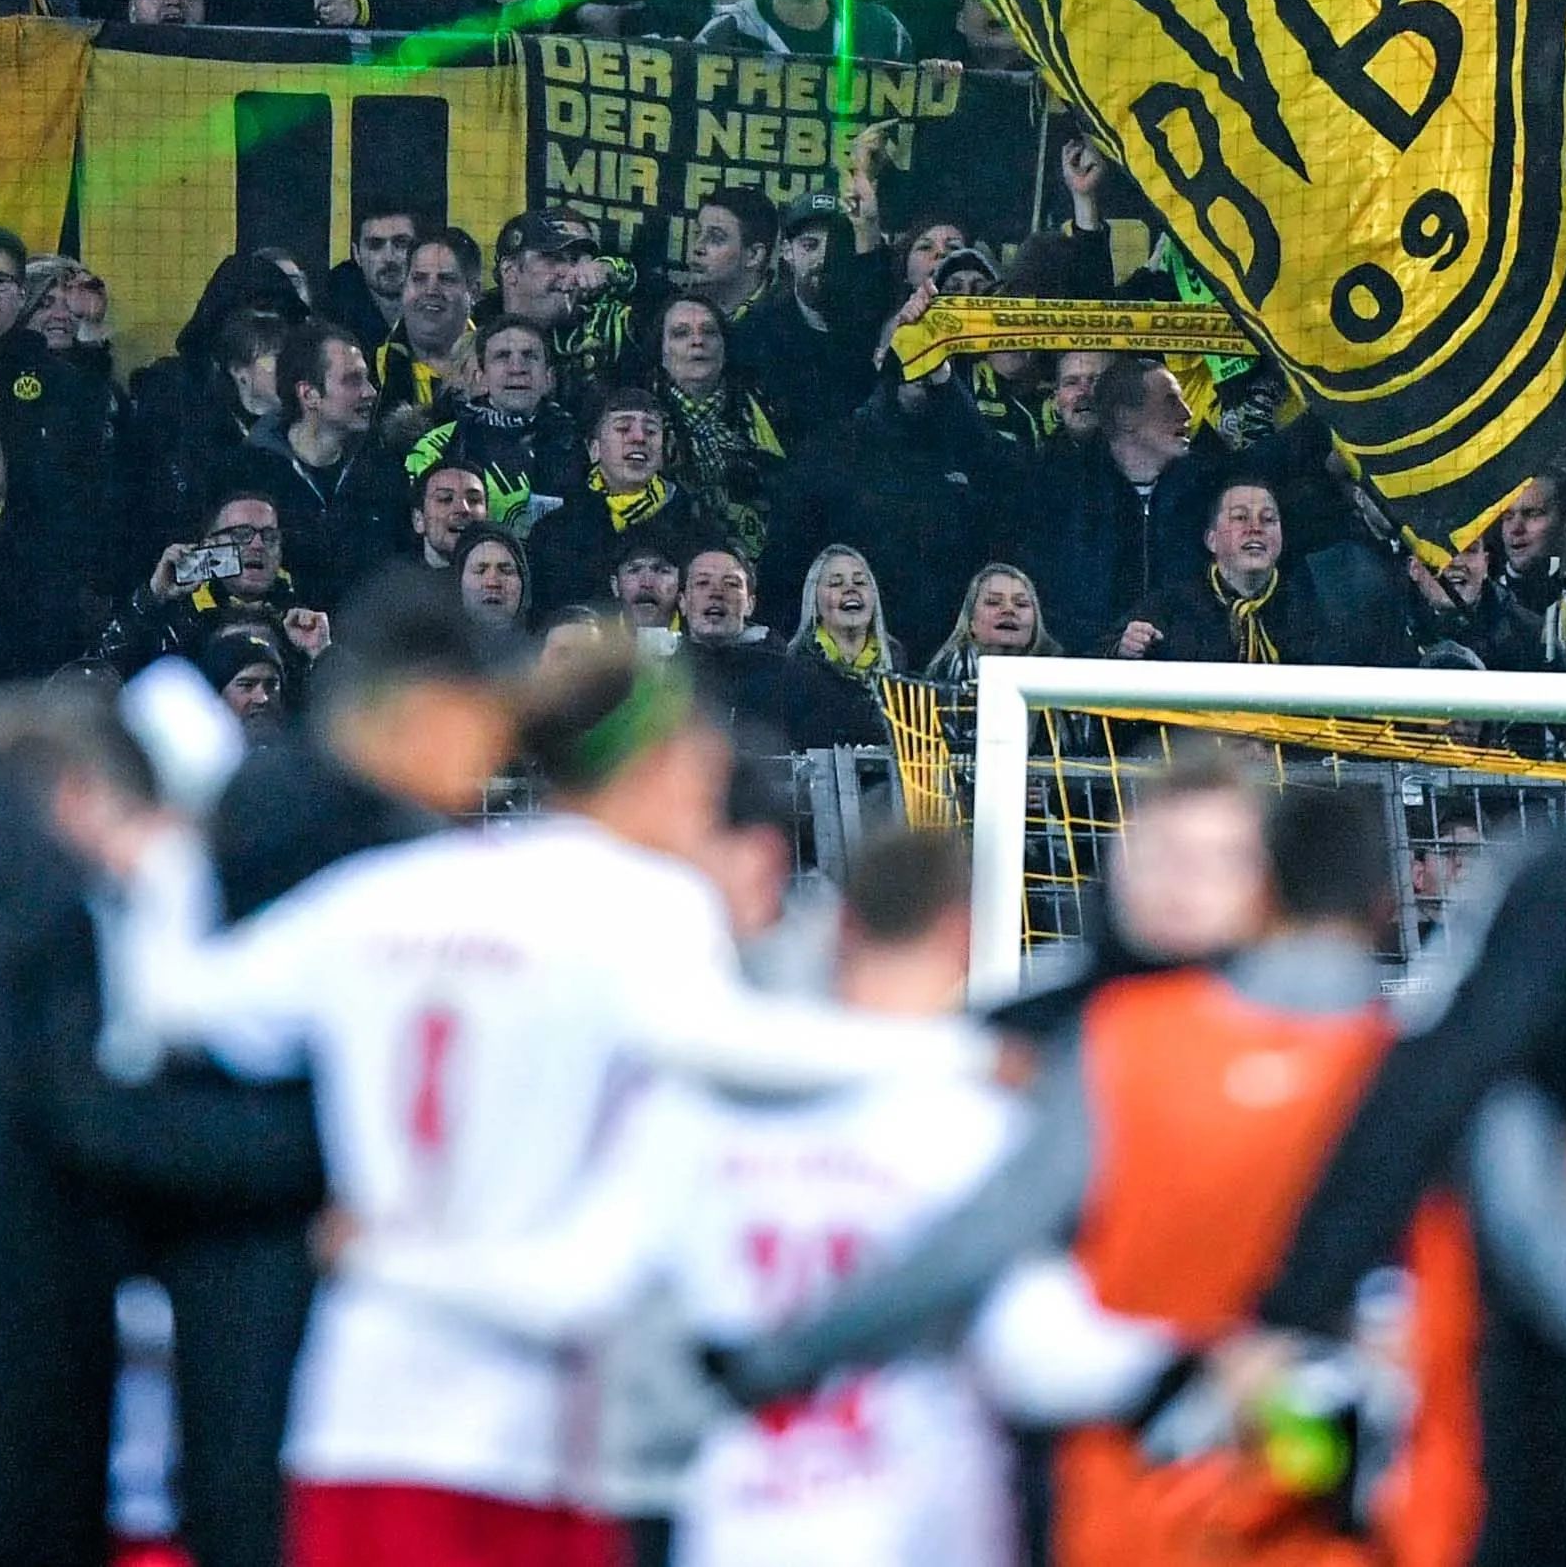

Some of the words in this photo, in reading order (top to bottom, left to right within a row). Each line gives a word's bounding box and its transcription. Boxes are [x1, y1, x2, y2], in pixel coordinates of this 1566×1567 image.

[539, 37, 673, 99] DER
[696, 52, 962, 120] FREUND
[544, 84, 673, 153] DER
[545, 141, 660, 207] MIR
[1330, 188, 1470, 343] 09
[944, 341, 977, 353] DIE
[988, 336, 1059, 349] MACHT
[1128, 336, 1244, 353] WESTFALEN
[993, 312, 1134, 330] BORUSSIA
